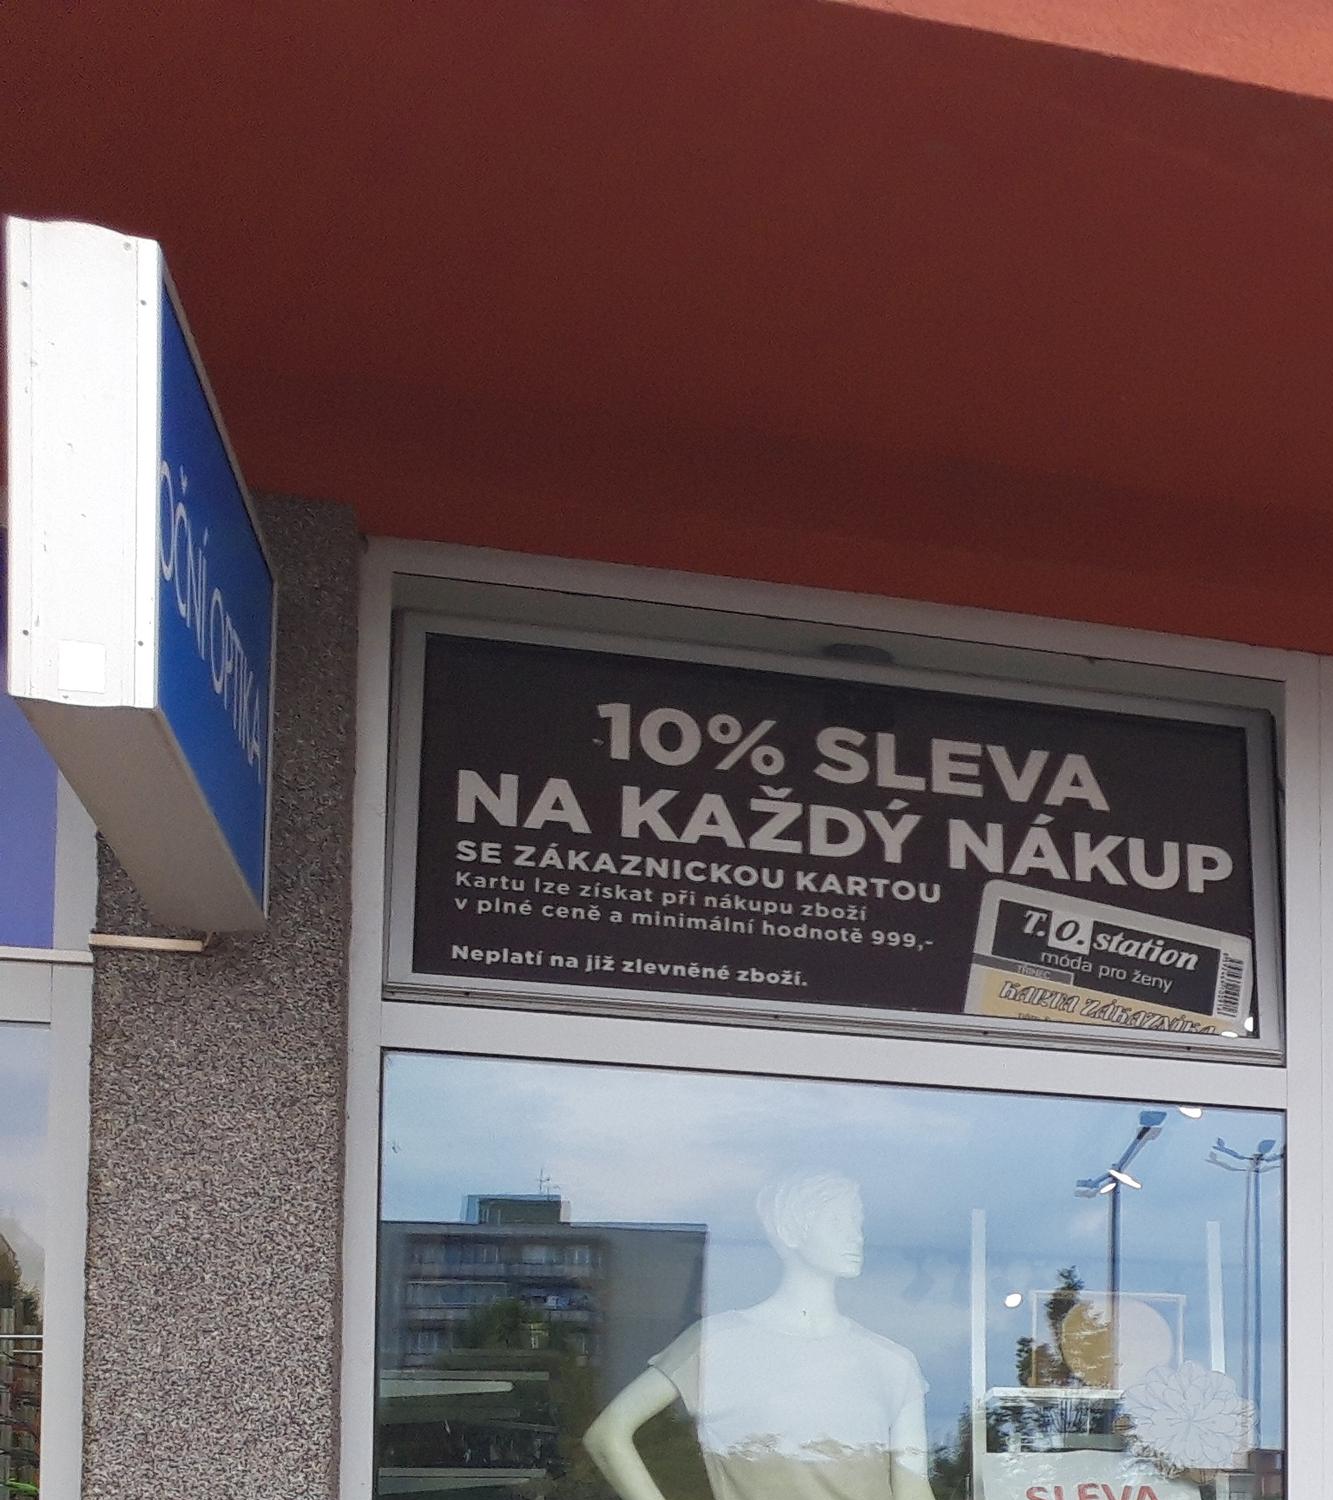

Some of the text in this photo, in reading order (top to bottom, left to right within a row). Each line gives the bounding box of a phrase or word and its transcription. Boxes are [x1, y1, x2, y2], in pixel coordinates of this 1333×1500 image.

[210, 586, 262, 786] OPTIKA
[597, 702, 1110, 812] 10% SLEVA
[456, 769, 1234, 894] NA KAŽDÝ NÁKUP
[456, 871, 868, 922] Kartu lze získat při nákupu zboží
[457, 839, 942, 904] SE ZÁKAZNICKOU KARTOU
[455, 894, 934, 952] v plné ceně a minimální hodnotě 999,-
[451, 944, 808, 987] Neplatí na již zlevněné zboží.
[1041, 950, 1174, 992] móda pro ženy
